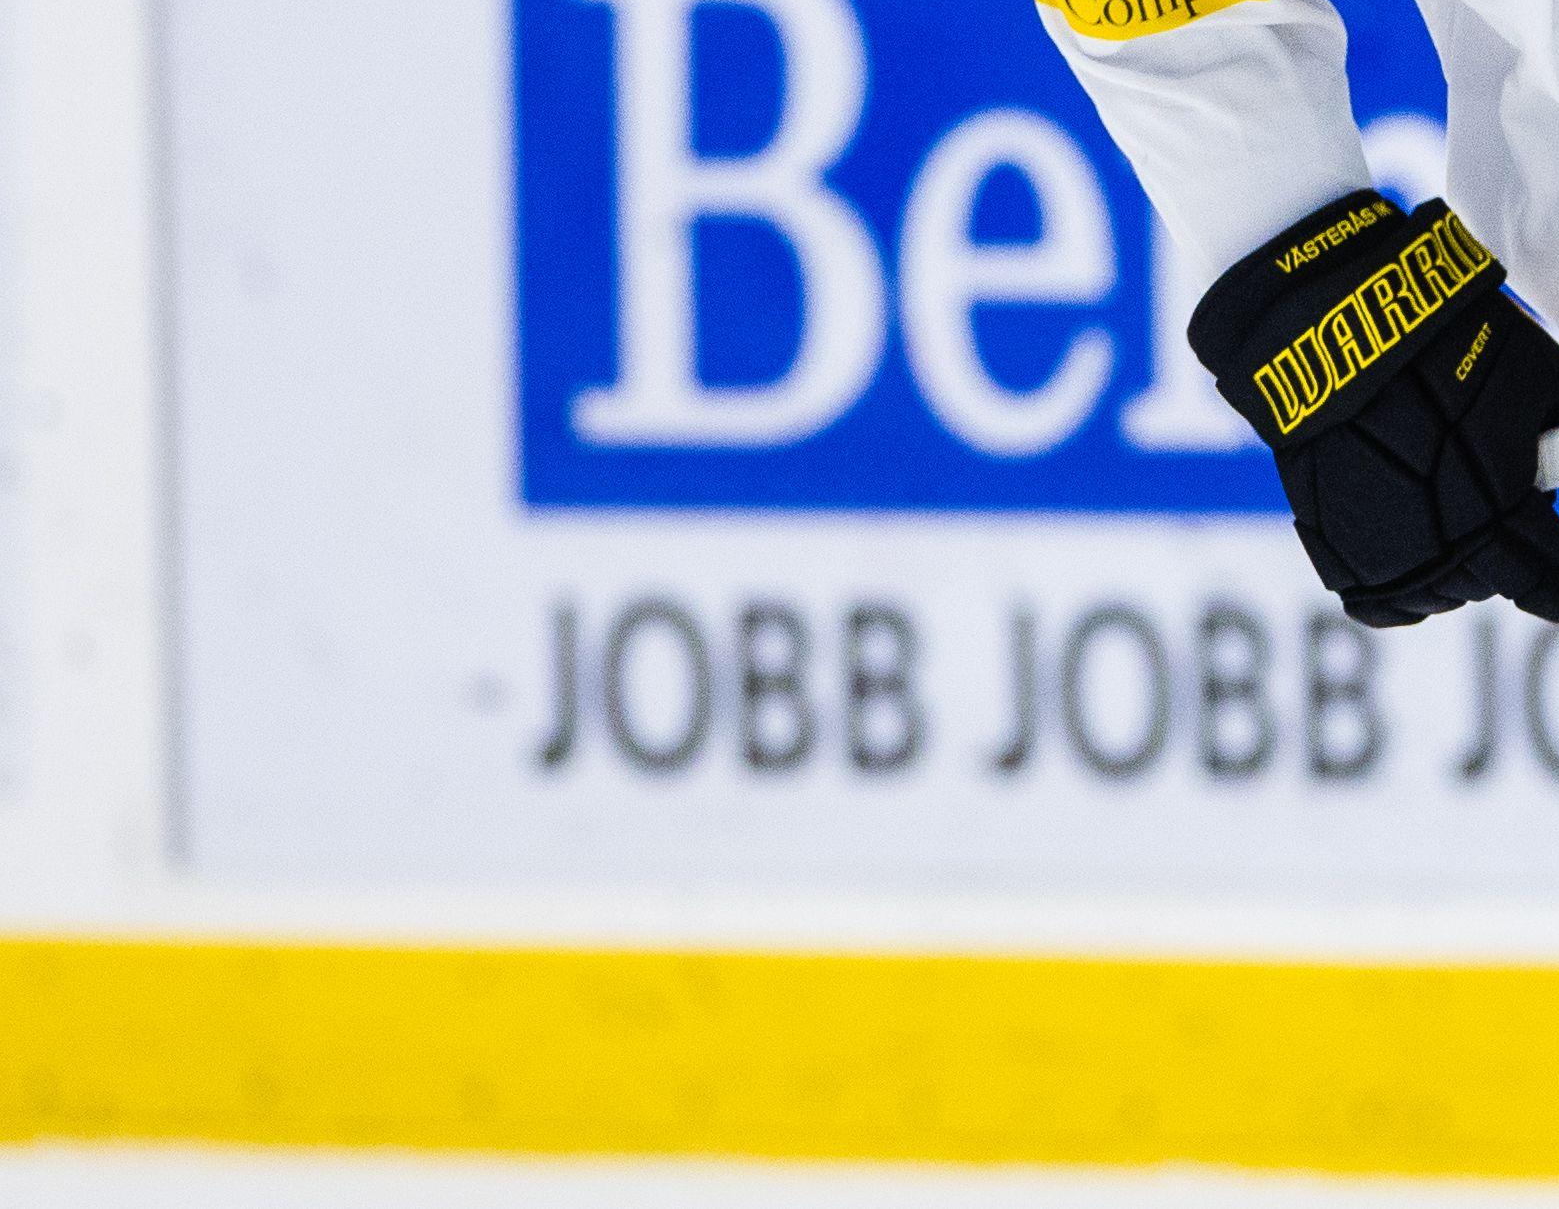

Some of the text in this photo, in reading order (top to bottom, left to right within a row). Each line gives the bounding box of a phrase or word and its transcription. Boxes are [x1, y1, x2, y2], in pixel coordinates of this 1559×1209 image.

[1253, 211, 1493, 435] WARRIO
[1455, 322, 1493, 383] COVERT
[533, 594, 926, 779] JOBB
[992, 601, 1392, 784] JOBB
